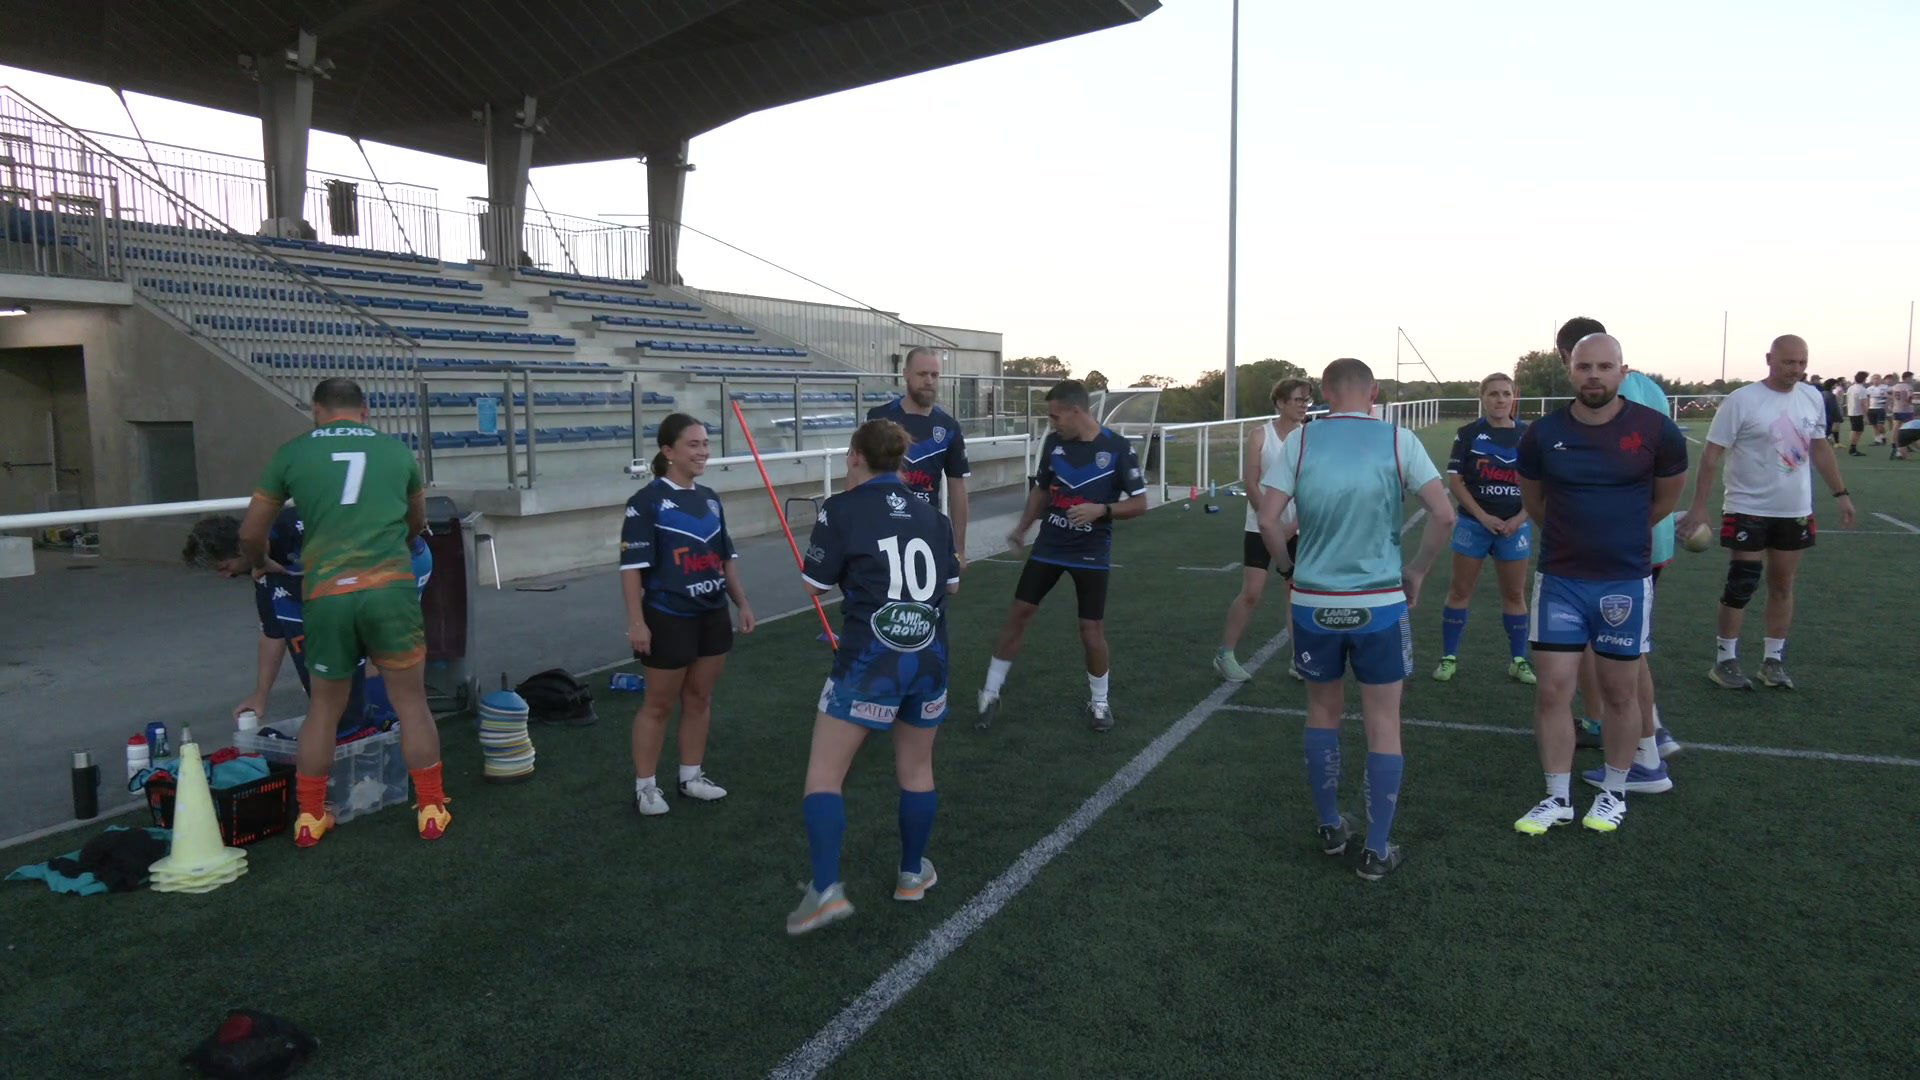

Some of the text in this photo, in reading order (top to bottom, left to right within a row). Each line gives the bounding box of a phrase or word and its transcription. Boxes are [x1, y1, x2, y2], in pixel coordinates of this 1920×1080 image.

[311, 427, 376, 438] ALEXIS
[331, 451, 367, 505] 7
[1479, 485, 1521, 496] TROYES
[877, 535, 937, 602] 10
[686, 578, 726, 598] TROY
[1596, 634, 1635, 647] KPMG
